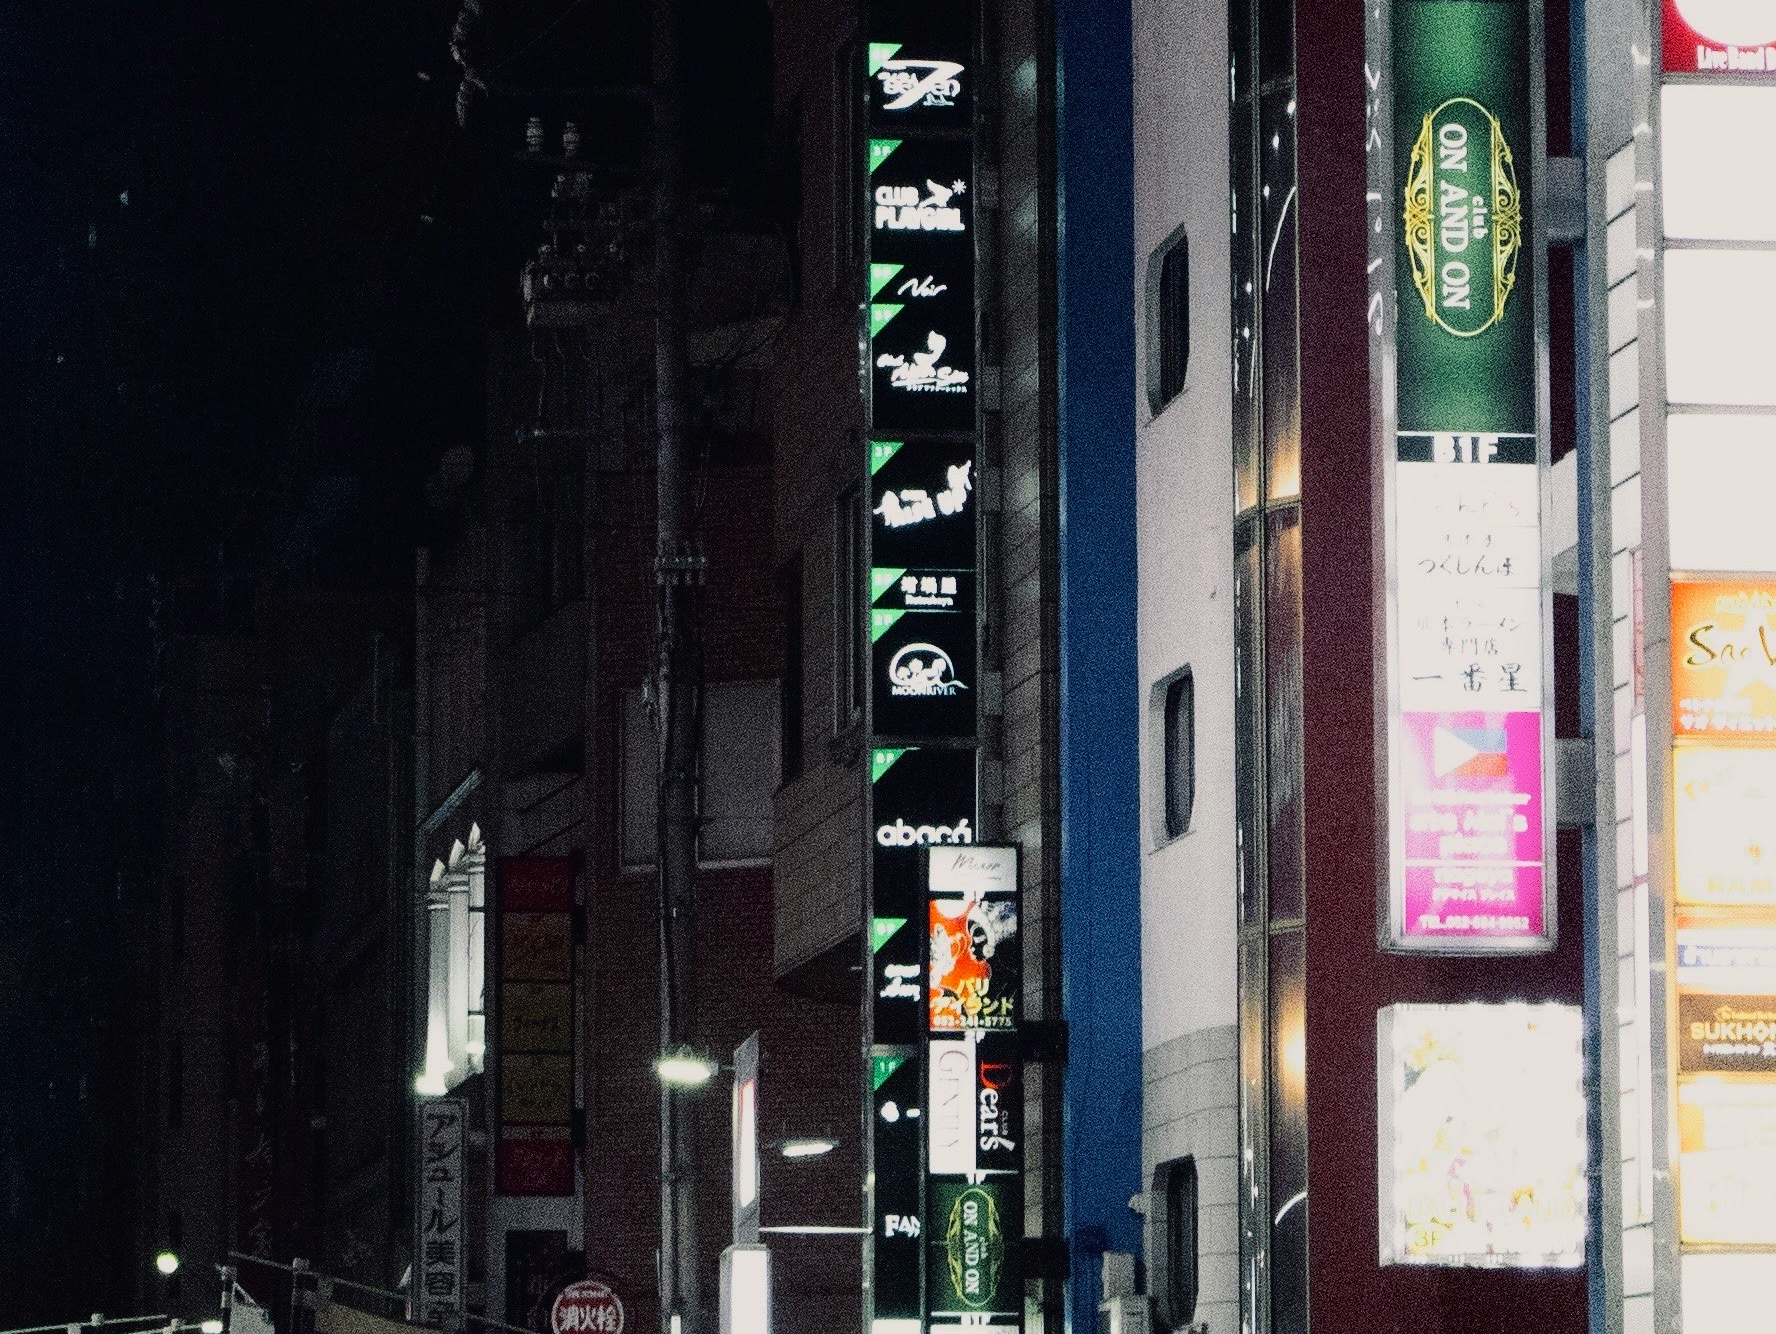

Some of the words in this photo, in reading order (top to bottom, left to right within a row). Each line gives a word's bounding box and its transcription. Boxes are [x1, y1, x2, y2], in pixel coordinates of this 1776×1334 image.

[1437, 123, 1469, 173] ON
[1439, 179, 1471, 254] AND
[1471, 196, 1486, 240] club
[1442, 261, 1472, 311] ON
[1411, 661, 1529, 694] 一番星
[963, 1200, 979, 1224] ON
[963, 1229, 979, 1266] AND
[964, 1269, 980, 1296] ON
[559, 1304, 618, 1332] 消火栓
